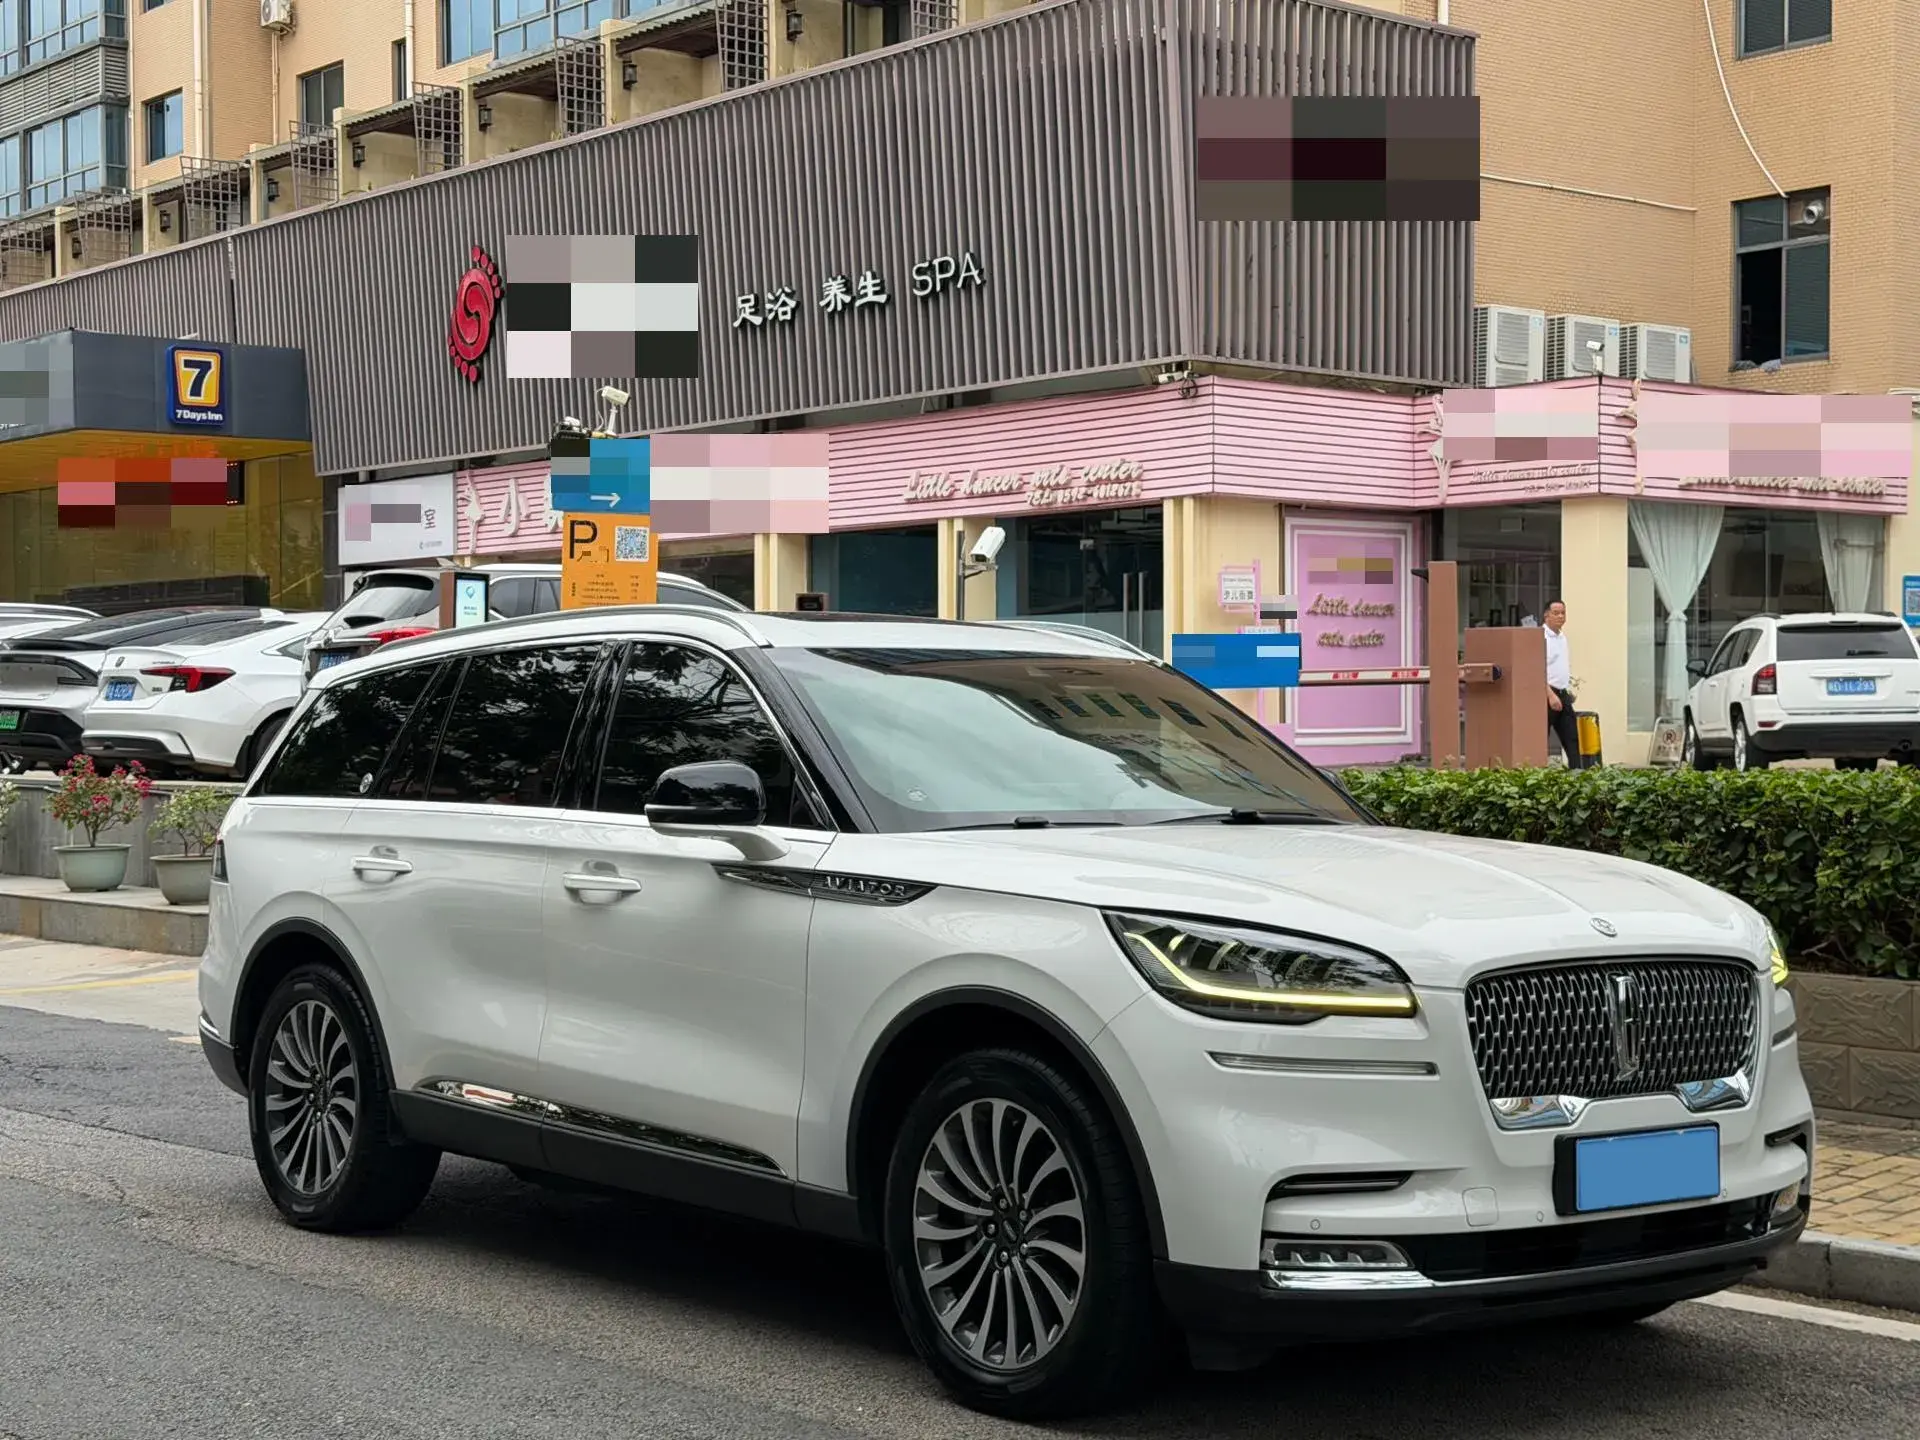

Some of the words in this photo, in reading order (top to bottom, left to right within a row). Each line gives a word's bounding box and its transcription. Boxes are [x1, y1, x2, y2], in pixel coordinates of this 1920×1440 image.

[733, 286, 798, 328] 足浴
[819, 270, 888, 313] 养生
[912, 251, 983, 297] SPA
[181, 356, 215, 400] 7
[1081, 458, 1143, 483] center
[569, 519, 598, 560] P
[824, 875, 905, 897] AVIATOR
